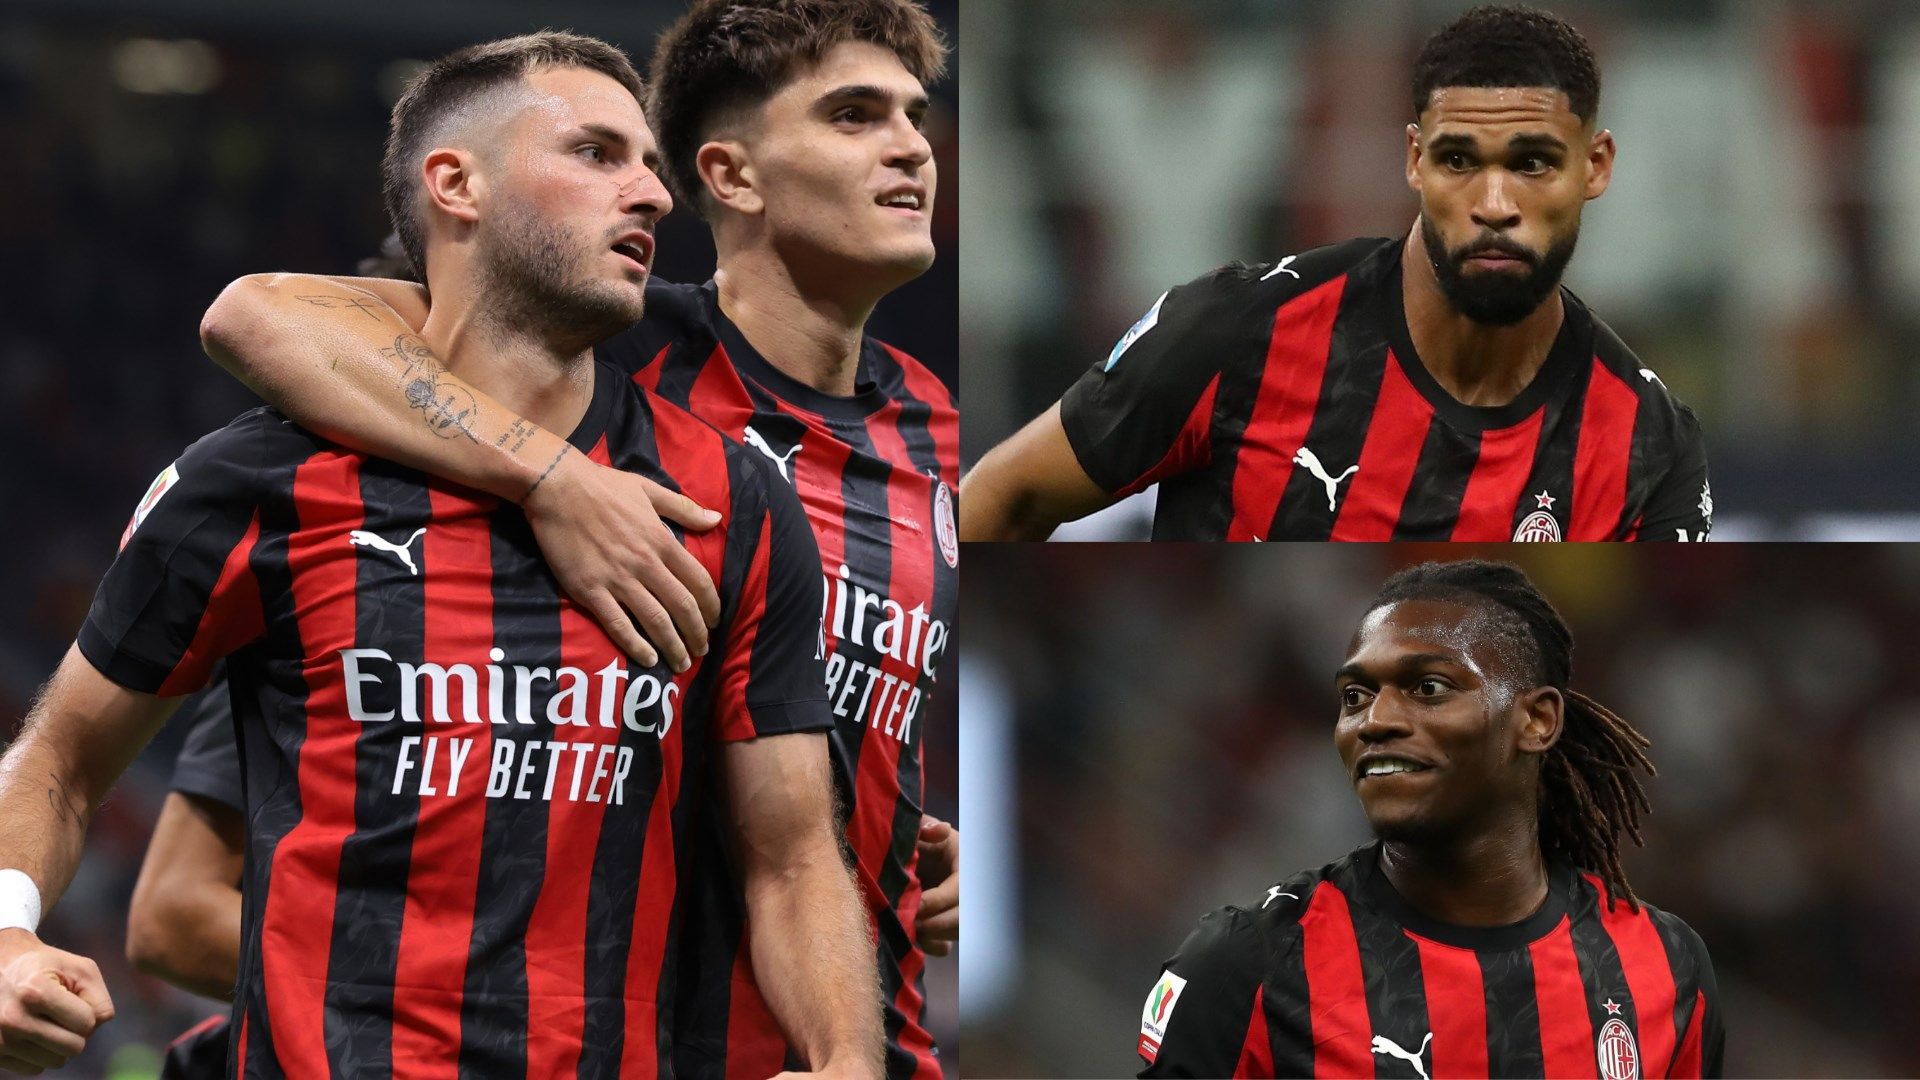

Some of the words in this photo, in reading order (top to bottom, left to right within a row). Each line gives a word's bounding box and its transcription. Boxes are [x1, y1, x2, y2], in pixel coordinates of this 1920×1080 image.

[1526, 517, 1552, 534] ACM
[822, 564, 950, 682] irate
[338, 647, 680, 741] Emirates
[825, 652, 922, 745] BETTER
[391, 736, 474, 798] FLY
[484, 738, 634, 806] BETTER
[1606, 1025, 1628, 1040] ACM
